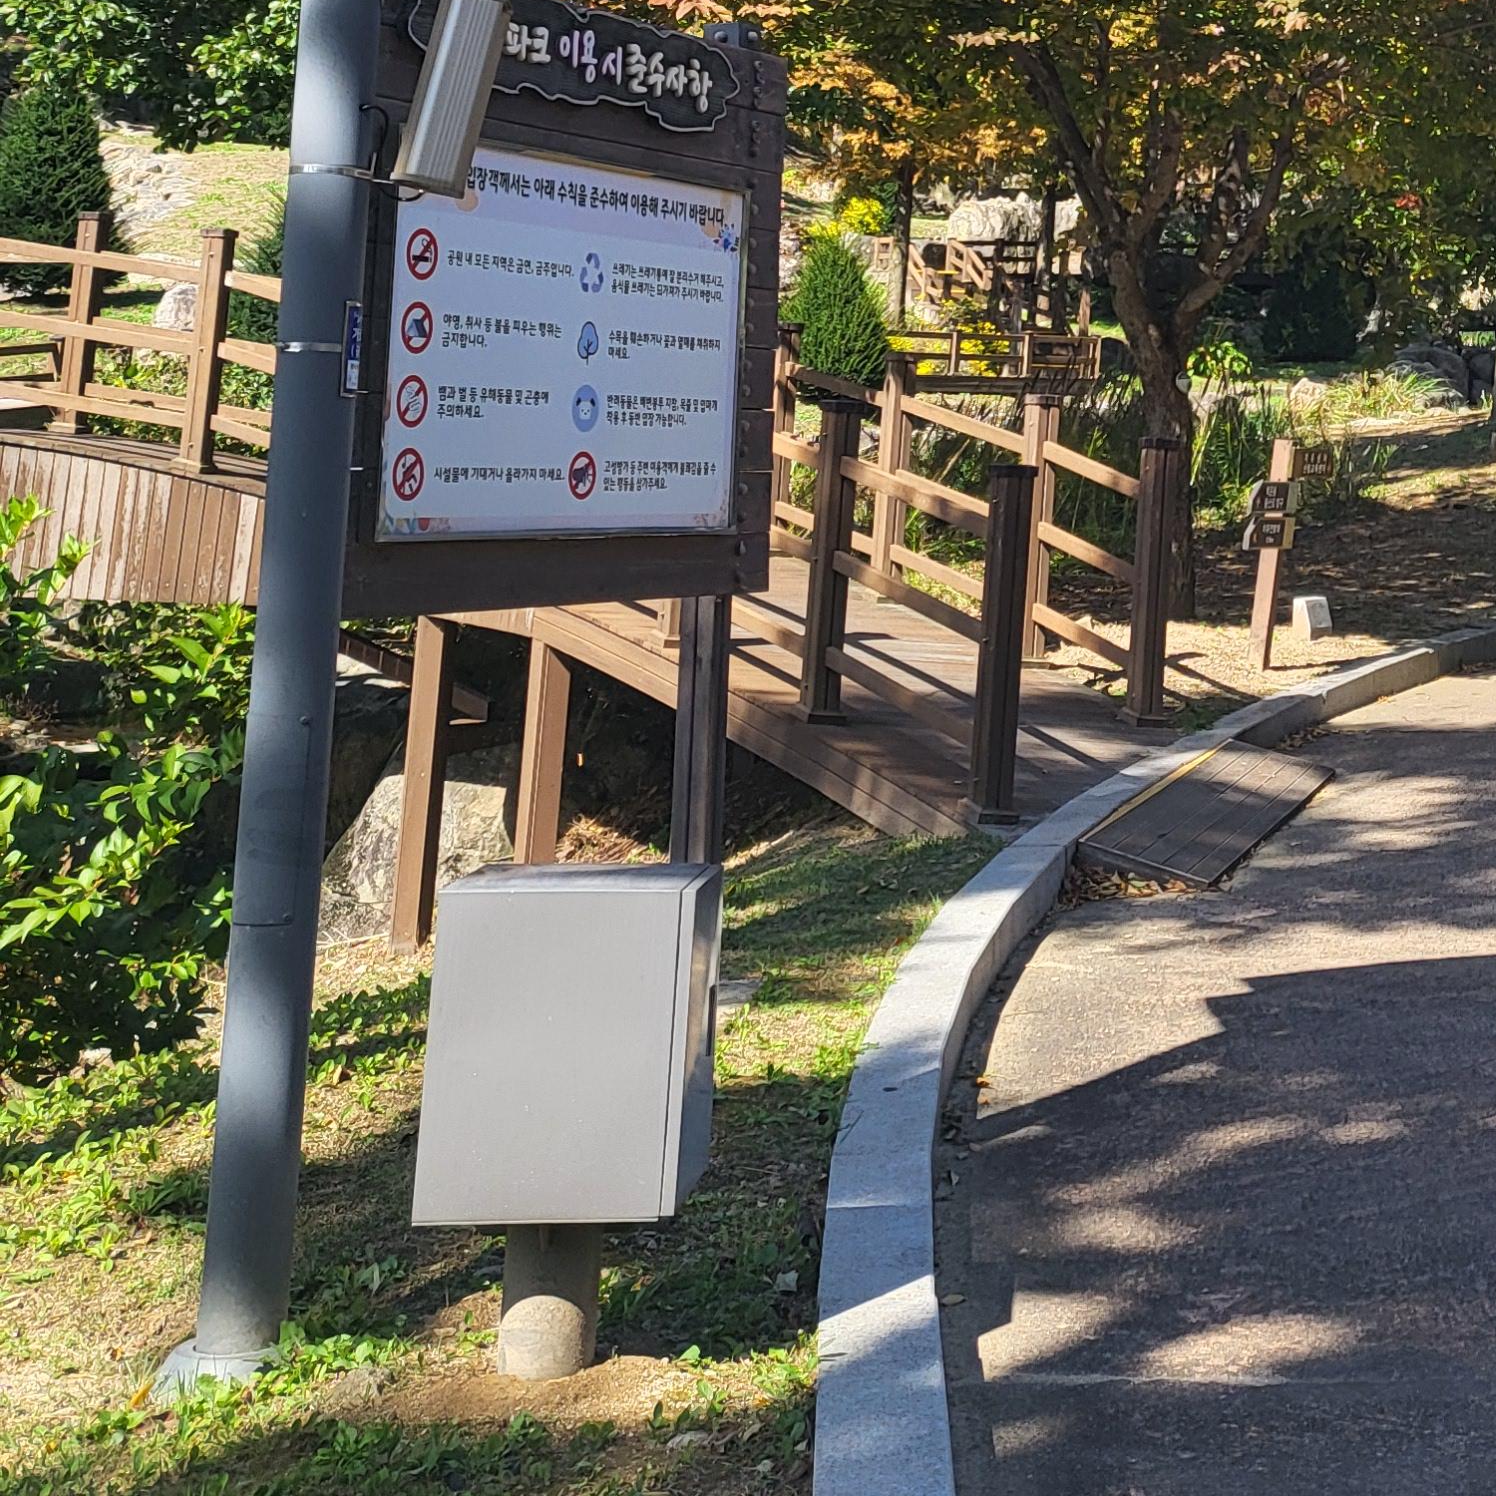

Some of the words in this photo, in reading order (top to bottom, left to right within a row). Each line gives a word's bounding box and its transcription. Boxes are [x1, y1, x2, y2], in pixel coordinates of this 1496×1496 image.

[559, 30, 598, 83] 이용
[602, 46, 622, 85] 시
[626, 43, 712, 113] 준수사항
[466, 166, 531, 197] 입장객께서는
[534, 178, 555, 201] 아래
[557, 181, 587, 207] 수칙을
[590, 187, 628, 213] 준수하여
[630, 194, 659, 217] 이용해
[661, 199, 687, 222] 주시기
[447, 250, 463, 266] 공원
[465, 252, 473, 265] 내
[474, 254, 490, 270] 모든
[492, 256, 515, 272] 지역은
[516, 258, 533, 274] 금연,
[536, 261, 575, 278] 금주입니다.
[612, 263, 637, 278] 쓰레기는
[637, 266, 668, 282] 쓰레기통에
[669, 269, 675, 283] 잘
[677, 271, 699, 285] 분리수거
[611, 279, 630, 294] 음식물
[631, 282, 655, 297] 쓰레기는
[681, 287, 698, 301] 주시기
[700, 289, 723, 303] 바랍니다.
[443, 314, 462, 330] 야영,
[465, 315, 482, 330] 취사
[484, 318, 492, 333] 등
[495, 318, 511, 334] 불을
[513, 320, 537, 336] 피우는
[538, 322, 562, 338] 행위는
[442, 331, 487, 348] 금지합니다.
[609, 329, 628, 345] 수목을
[630, 331, 662, 346] 훼손하거나
[664, 334, 676, 349] 꽃과
[678, 336, 695, 351] 열매를
[697, 337, 720, 351] 채취하지
[608, 346, 630, 359] 마세요.
[438, 386, 456, 401] 뱀과
[458, 387, 467, 402] 벌
[469, 387, 478, 403] 등
[480, 387, 513, 405] 유해동물
[515, 389, 523, 405] 및
[524, 390, 549, 406] 곤충에
[607, 395, 638, 410] 반려동물은
[640, 396, 664, 411] 배변봉투
[680, 398, 691, 412] 목줄
[693, 399, 698, 413] 및
[700, 400, 717, 413] 입마개
[437, 404, 484, 419] 주의하세요.
[607, 411, 619, 425] 착용
[621, 411, 627, 425] 후
[629, 412, 640, 426] 동반
[642, 413, 654, 427] 입장
[655, 413, 686, 428] 가능합니다.
[434, 467, 468, 483] 시설물에
[471, 467, 503, 480] 기대거나
[505, 467, 536, 483] 올라가지
[539, 468, 565, 481] 마세요.
[603, 460, 629, 475] 고성방가
[630, 461, 636, 475] 등
[637, 461, 648, 475] 주변
[710, 462, 716, 475] 수
[603, 477, 616, 492] 있는
